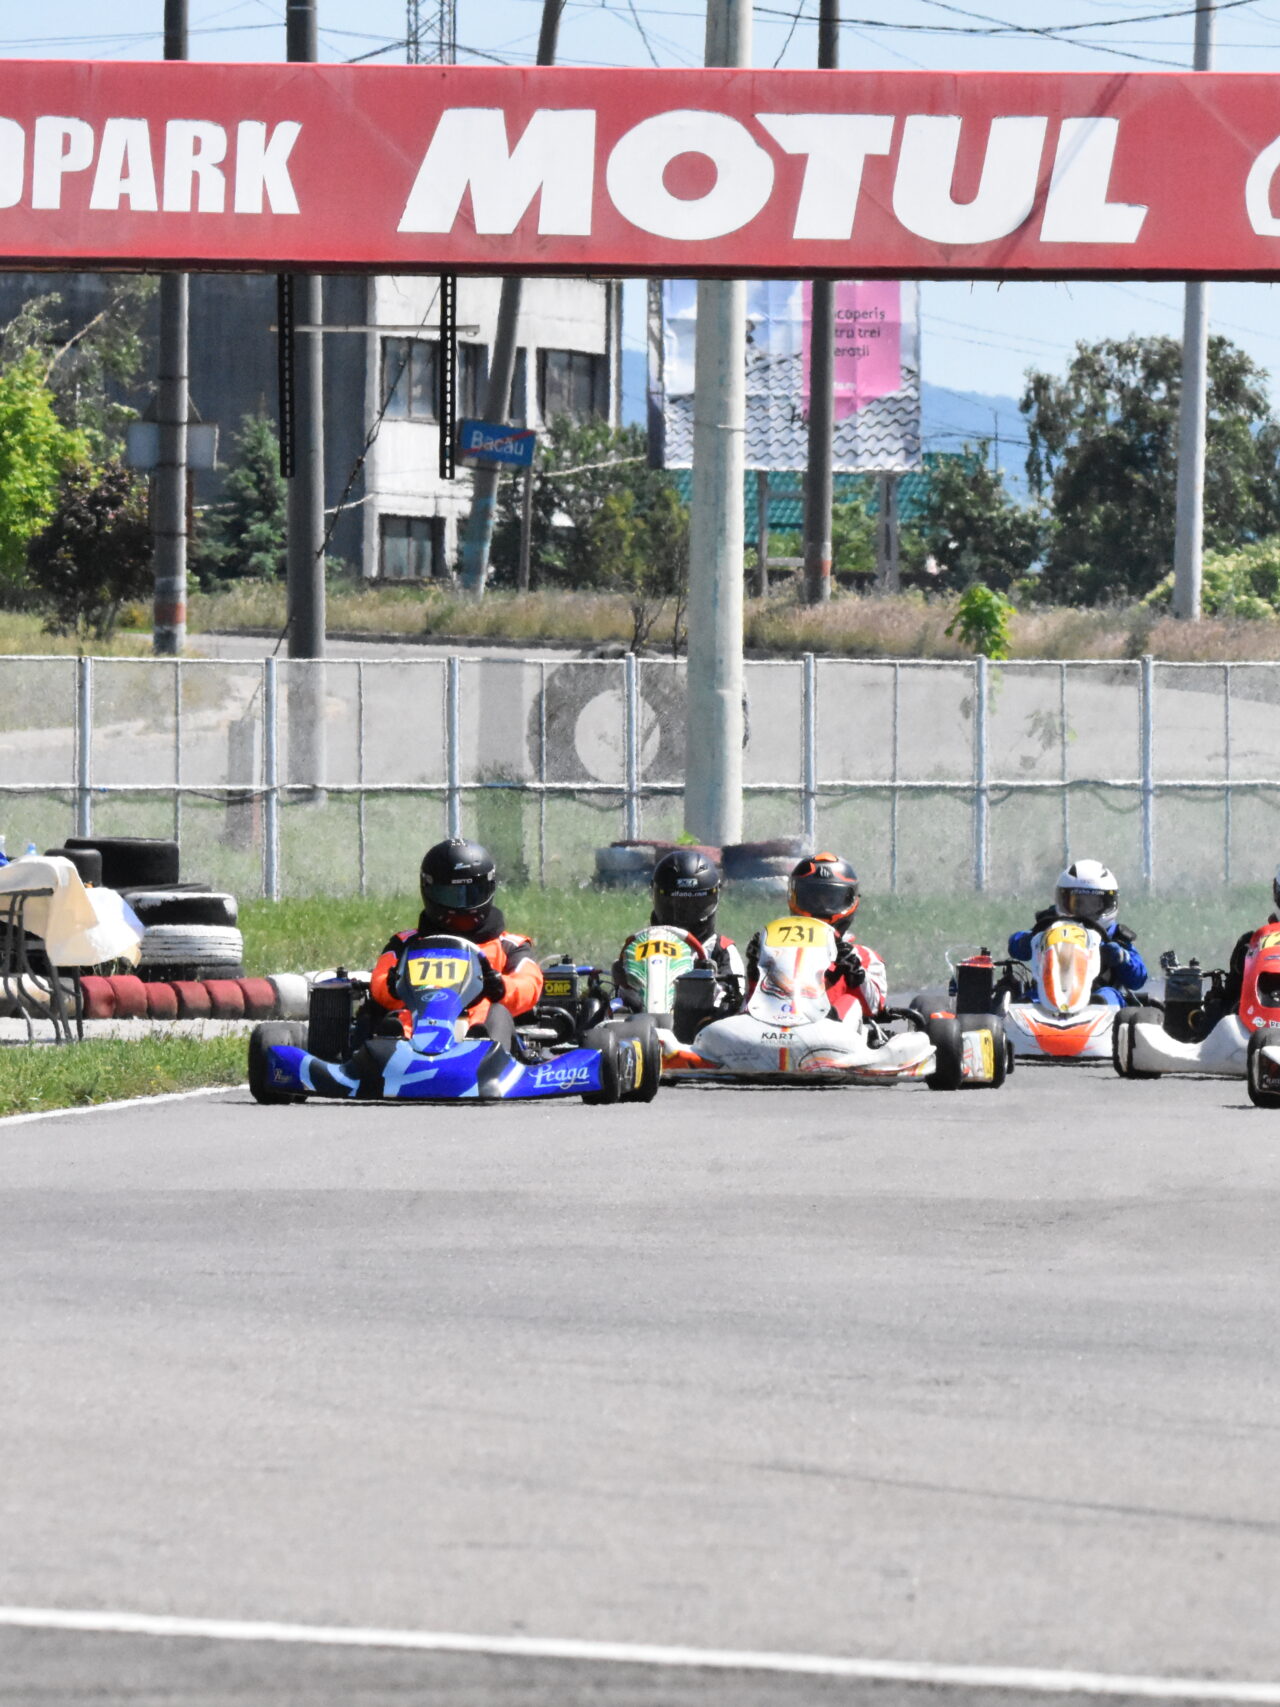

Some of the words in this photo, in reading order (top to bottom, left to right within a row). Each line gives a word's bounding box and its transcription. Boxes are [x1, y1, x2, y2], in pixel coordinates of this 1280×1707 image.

[397, 108, 1148, 244] MOTUL
[858, 327, 881, 338] trei
[470, 430, 524, 456] Bacău
[778, 925, 814, 943] 731
[638, 940, 677, 958] 715
[417, 960, 456, 981] 711
[544, 983, 571, 994] OMP
[761, 1032, 795, 1040] KART
[528, 1064, 590, 1090] Praga
